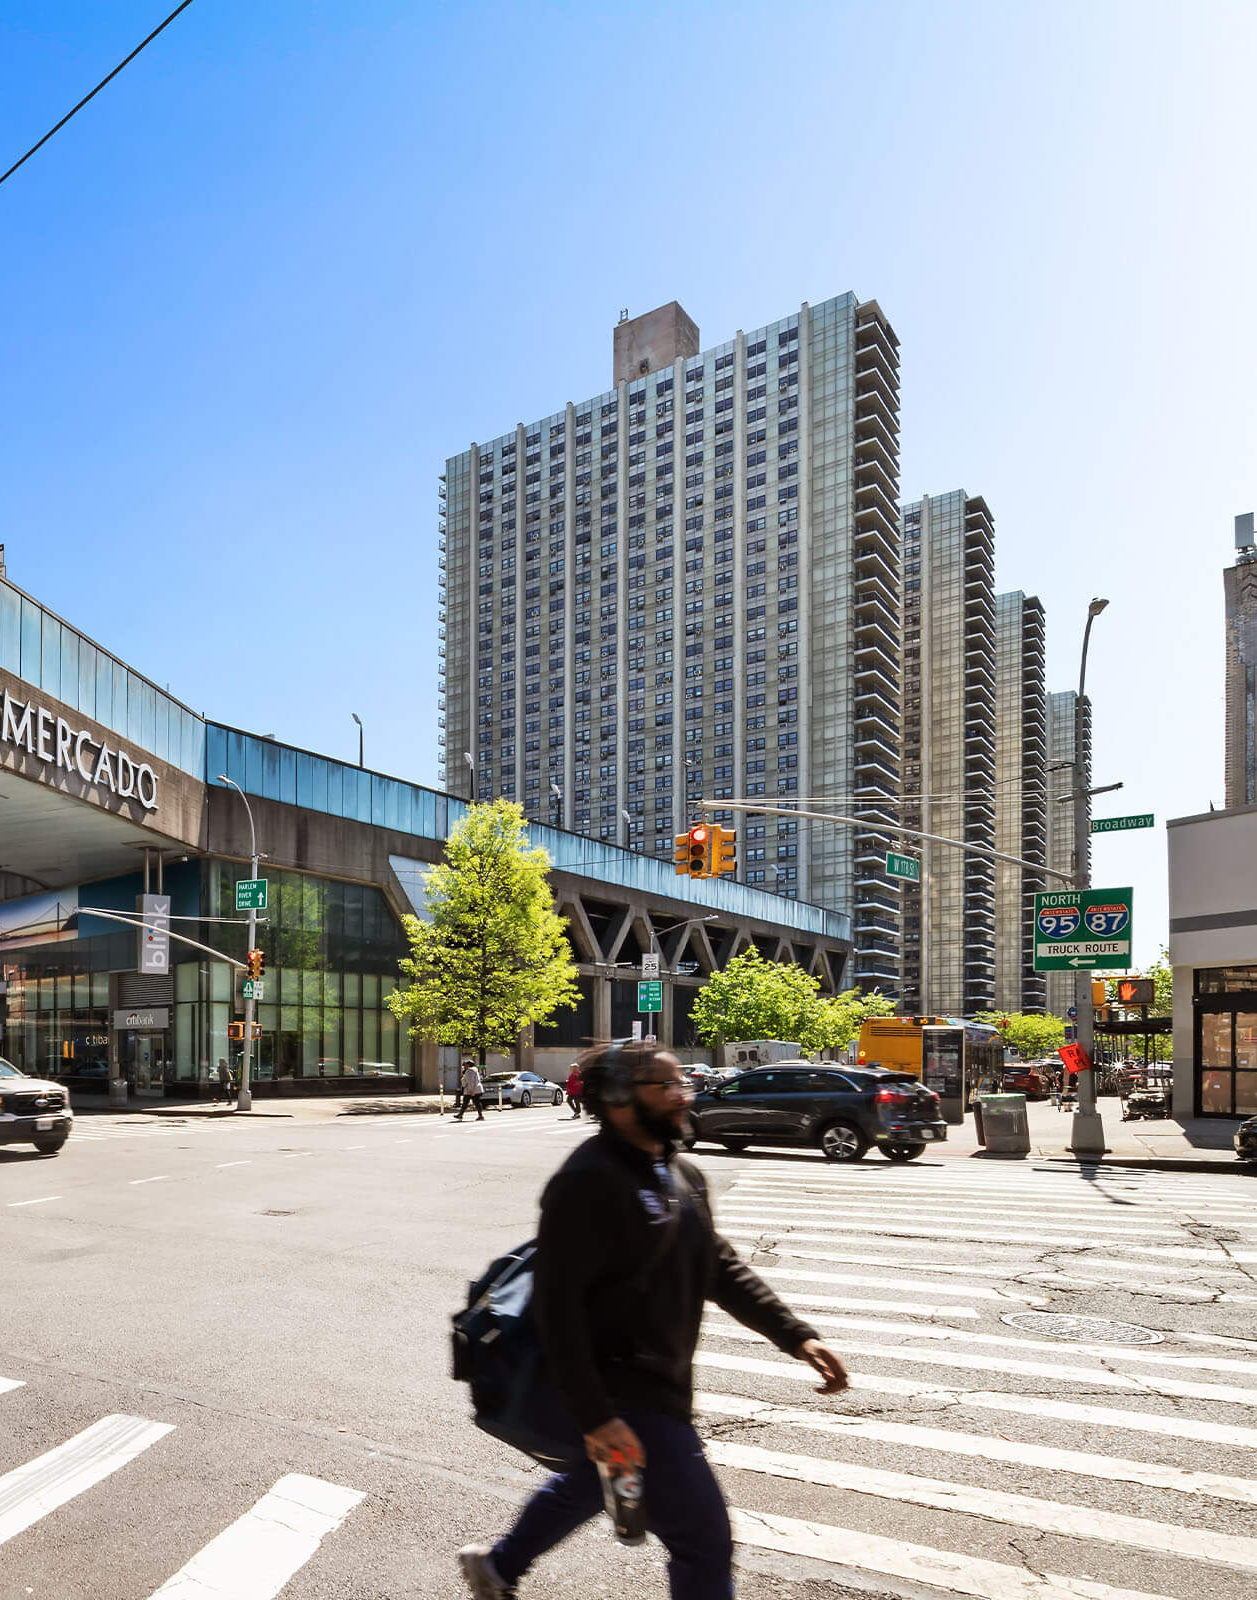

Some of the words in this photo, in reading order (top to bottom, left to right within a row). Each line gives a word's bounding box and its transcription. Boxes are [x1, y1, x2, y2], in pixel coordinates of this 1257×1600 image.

[1, 688, 157, 809] MERCADO
[1092, 817, 1153, 831] Broadway
[894, 858, 900, 873] W
[1041, 894, 1081, 906] NORTH
[1042, 916, 1075, 934] 95
[1090, 913, 1124, 931] 87
[145, 904, 167, 968] blink
[1047, 945, 1080, 954] TRUCK
[1085, 943, 1119, 953] ROUTE
[644, 963, 657, 971] 25
[126, 1013, 154, 1025] citibank
